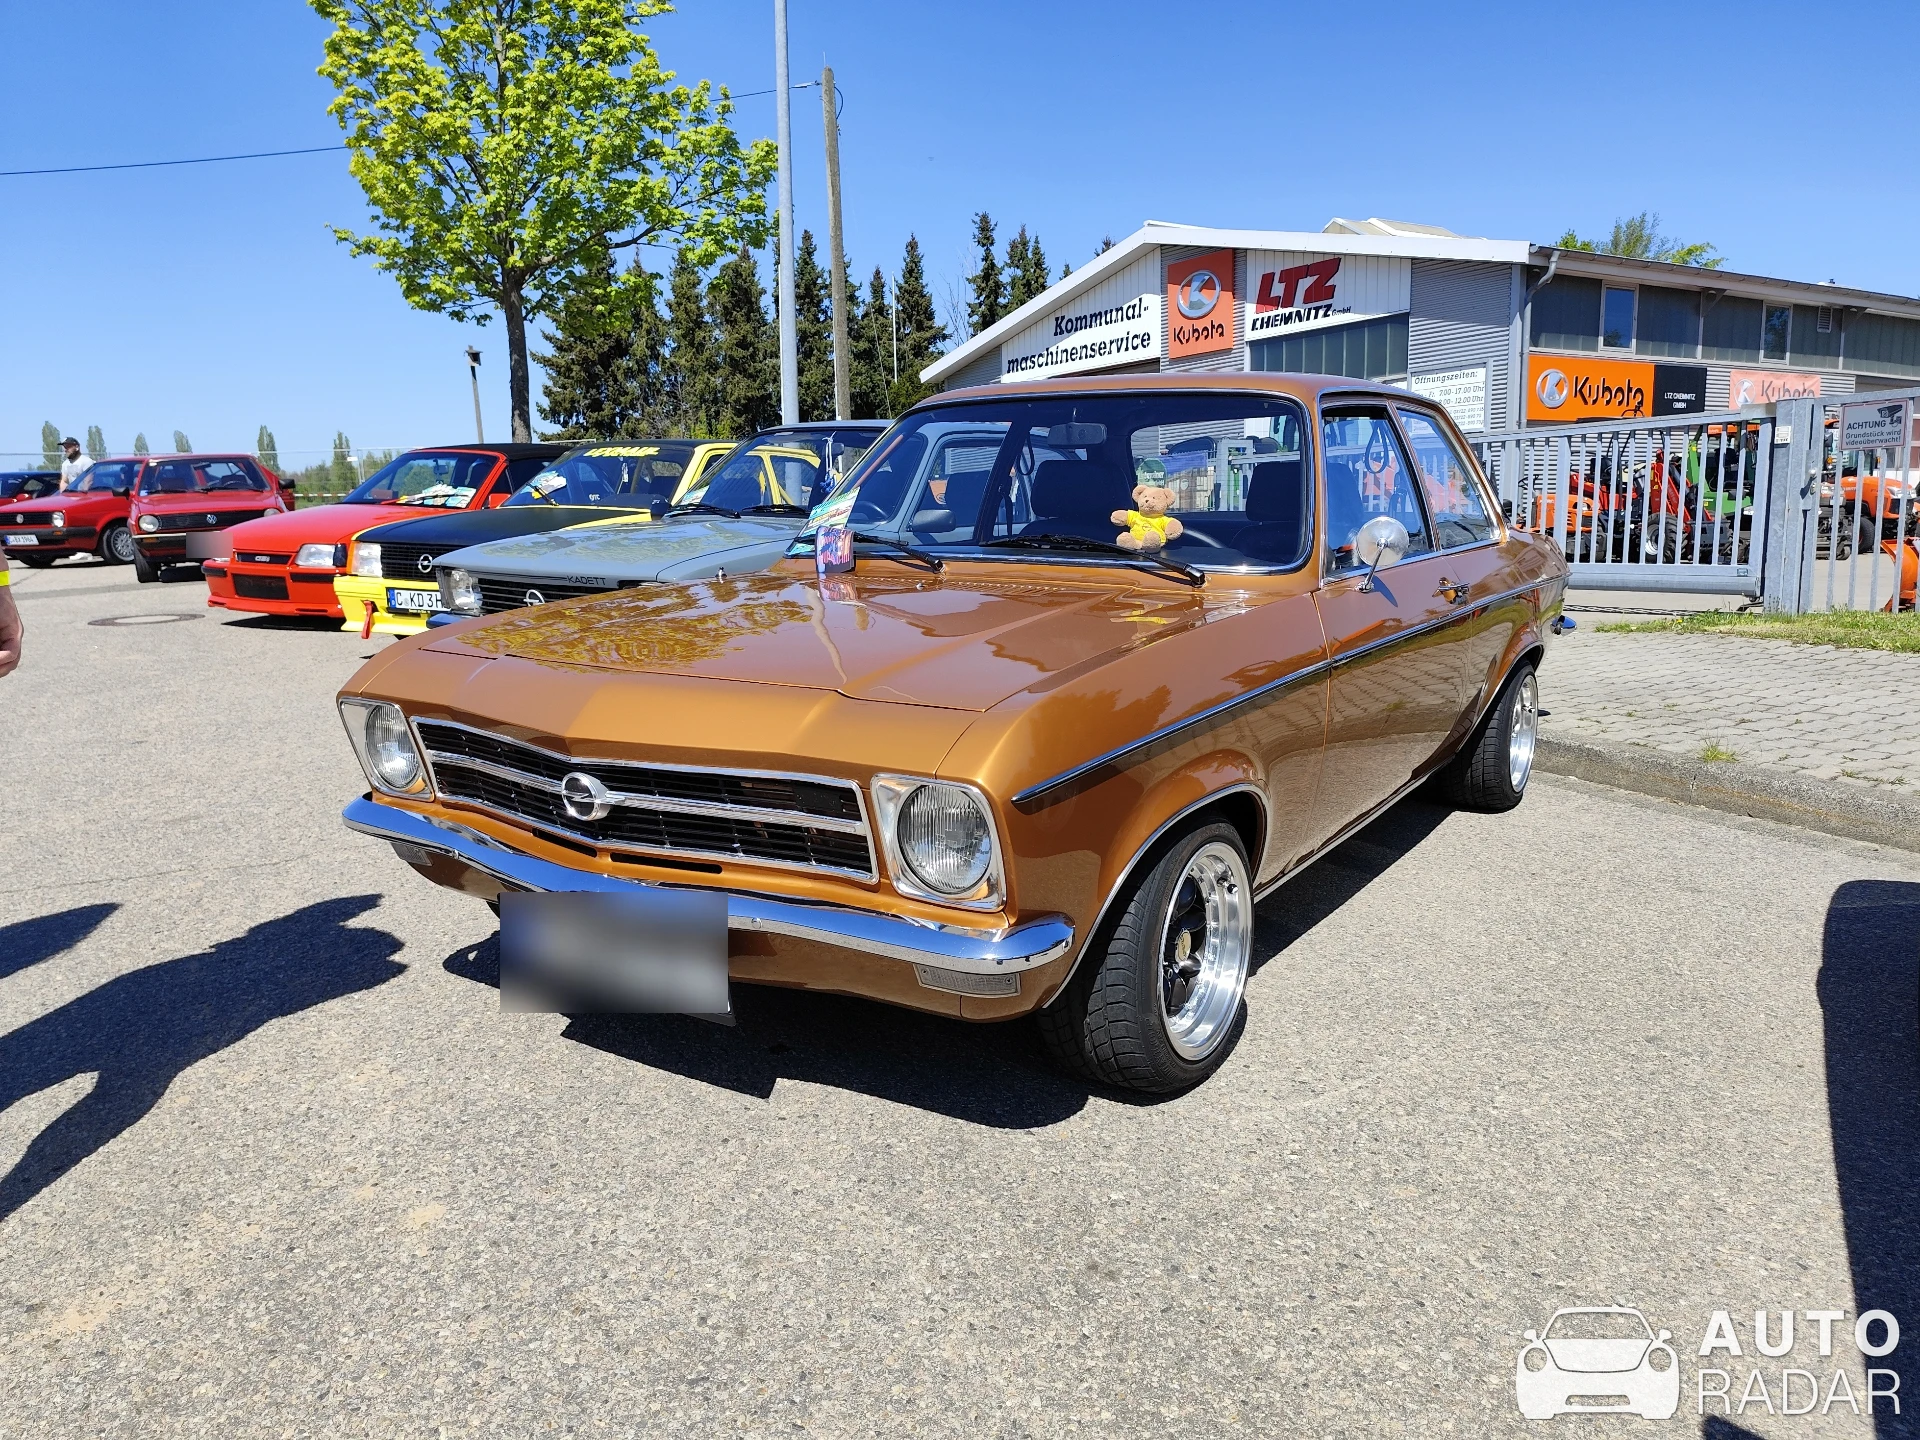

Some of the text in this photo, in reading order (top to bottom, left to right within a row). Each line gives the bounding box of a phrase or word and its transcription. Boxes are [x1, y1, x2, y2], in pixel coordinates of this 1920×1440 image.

[1255, 256, 1342, 314] LTZ
[1053, 297, 1149, 337] Kommunal-
[1251, 303, 1333, 331] CHEMNITZ
[1173, 319, 1225, 345] Kubota
[1006, 331, 1151, 374] maschinenservice
[1573, 375, 1644, 407] Kubota
[1845, 430, 1885, 439] Grundstück
[1846, 420, 1887, 430] ACHTUNG
[1845, 436, 1901, 446] videoüberwacht!
[567, 576, 606, 585] KADETT
[396, 591, 403, 606] C
[409, 592, 424, 608] KD
